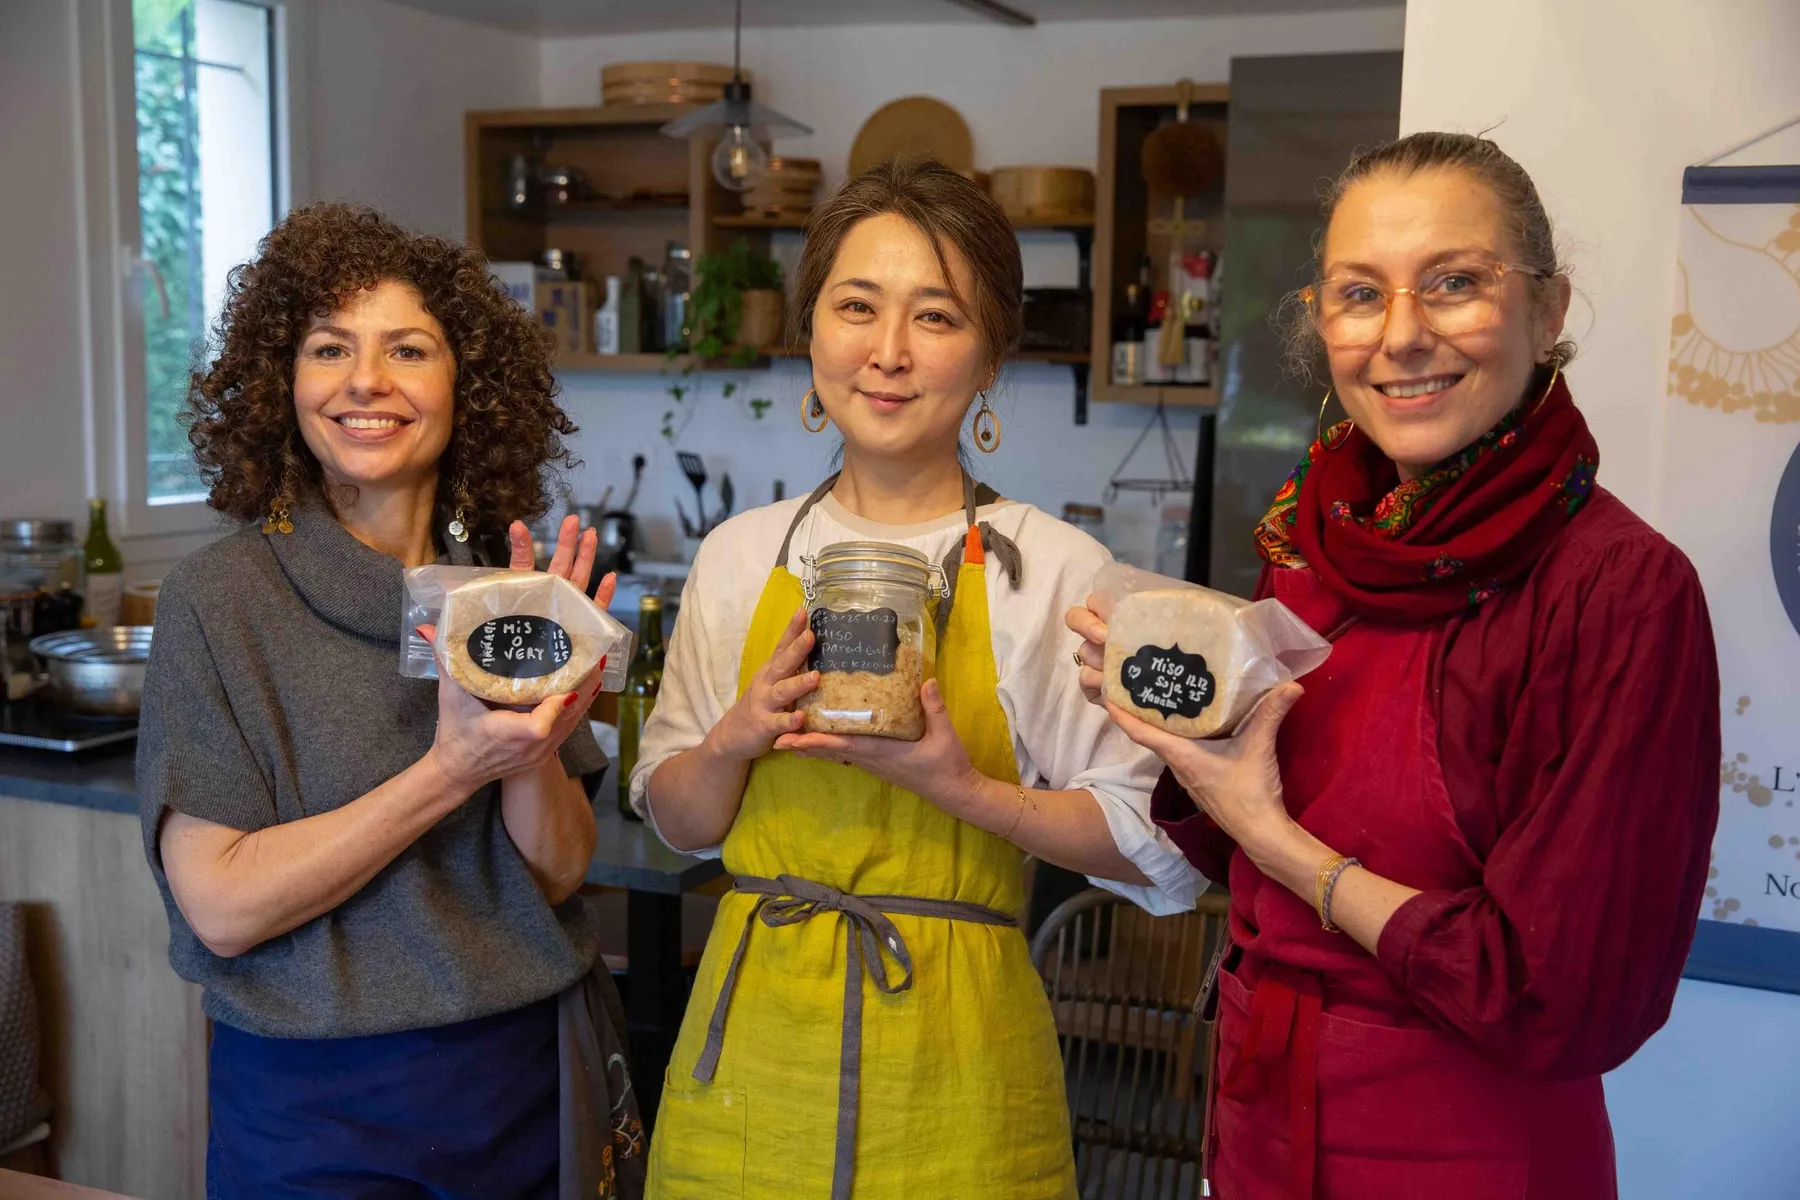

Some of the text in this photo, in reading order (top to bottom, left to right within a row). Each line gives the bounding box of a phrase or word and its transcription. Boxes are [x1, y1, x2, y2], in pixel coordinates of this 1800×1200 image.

[553, 628, 565, 640] 12
[554, 651, 569, 663] 25
[1188, 690, 1205, 702] 25
